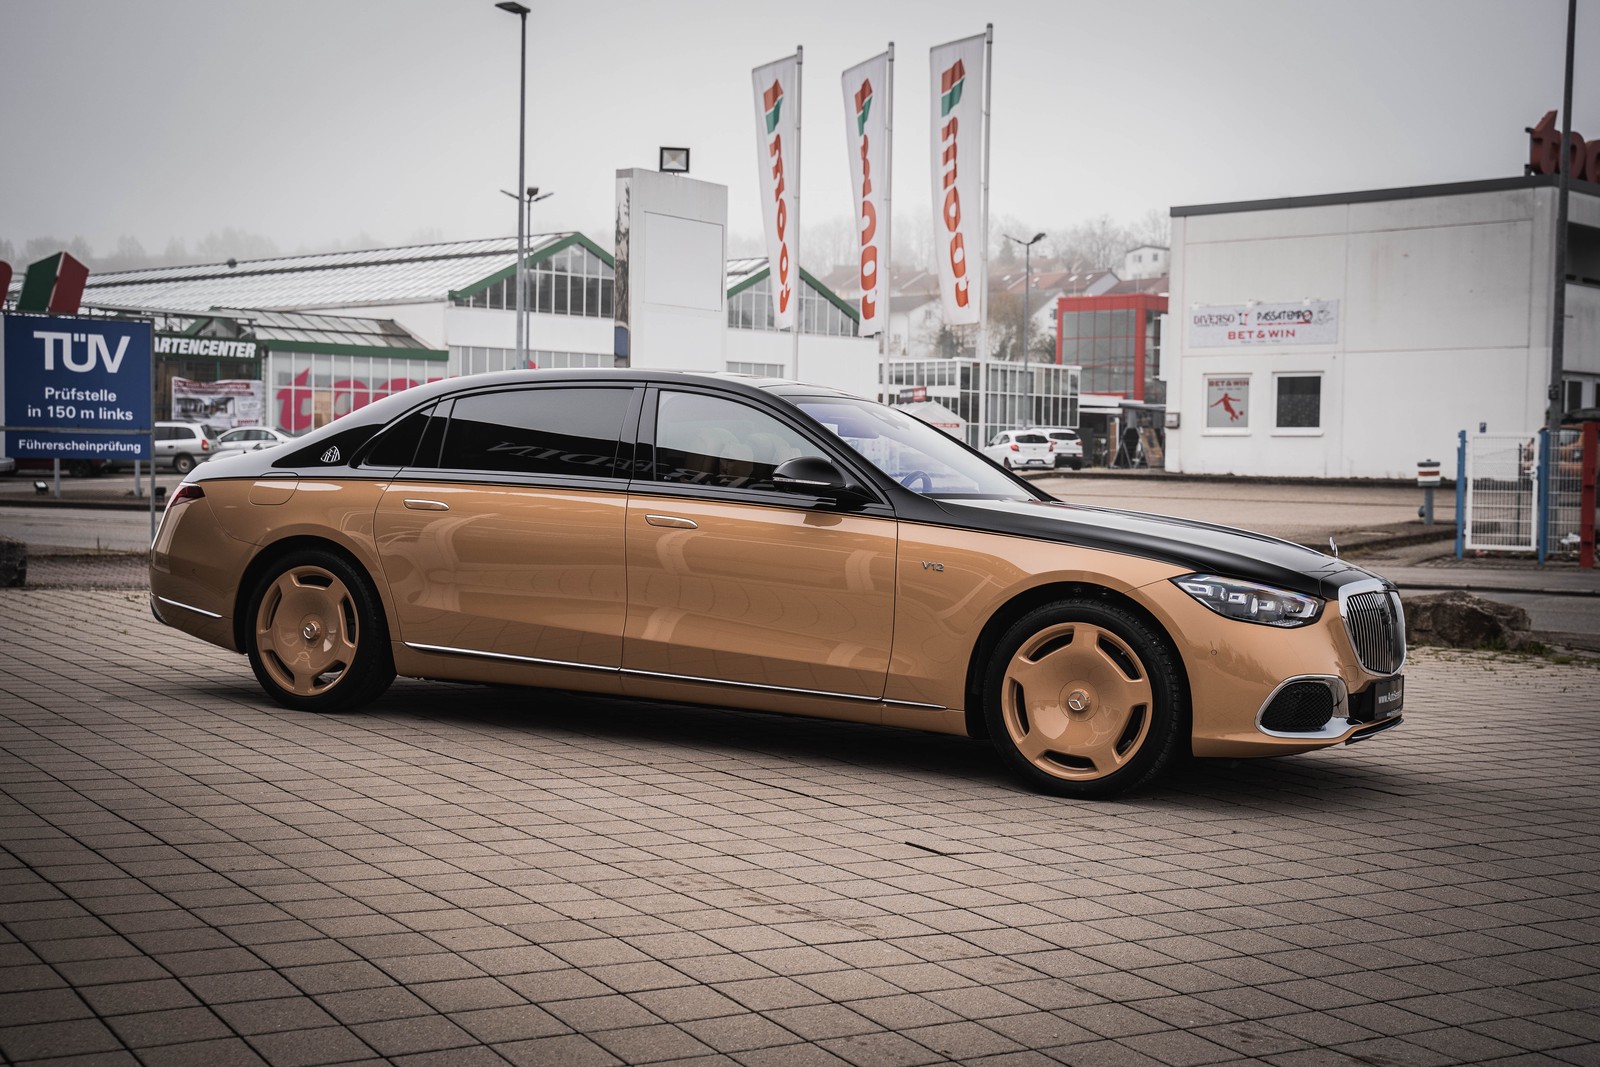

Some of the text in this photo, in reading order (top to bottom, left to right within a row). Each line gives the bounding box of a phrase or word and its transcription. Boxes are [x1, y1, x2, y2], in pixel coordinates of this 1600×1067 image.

[1228, 329, 1296, 340] BET & WIN
[33, 331, 131, 373] TÜV
[44, 387, 117, 402] Prüfstelle
[27, 404, 133, 421] in 150 m links
[18, 439, 141, 454] Führerscheinprüfung
[921, 560, 945, 572] V12
